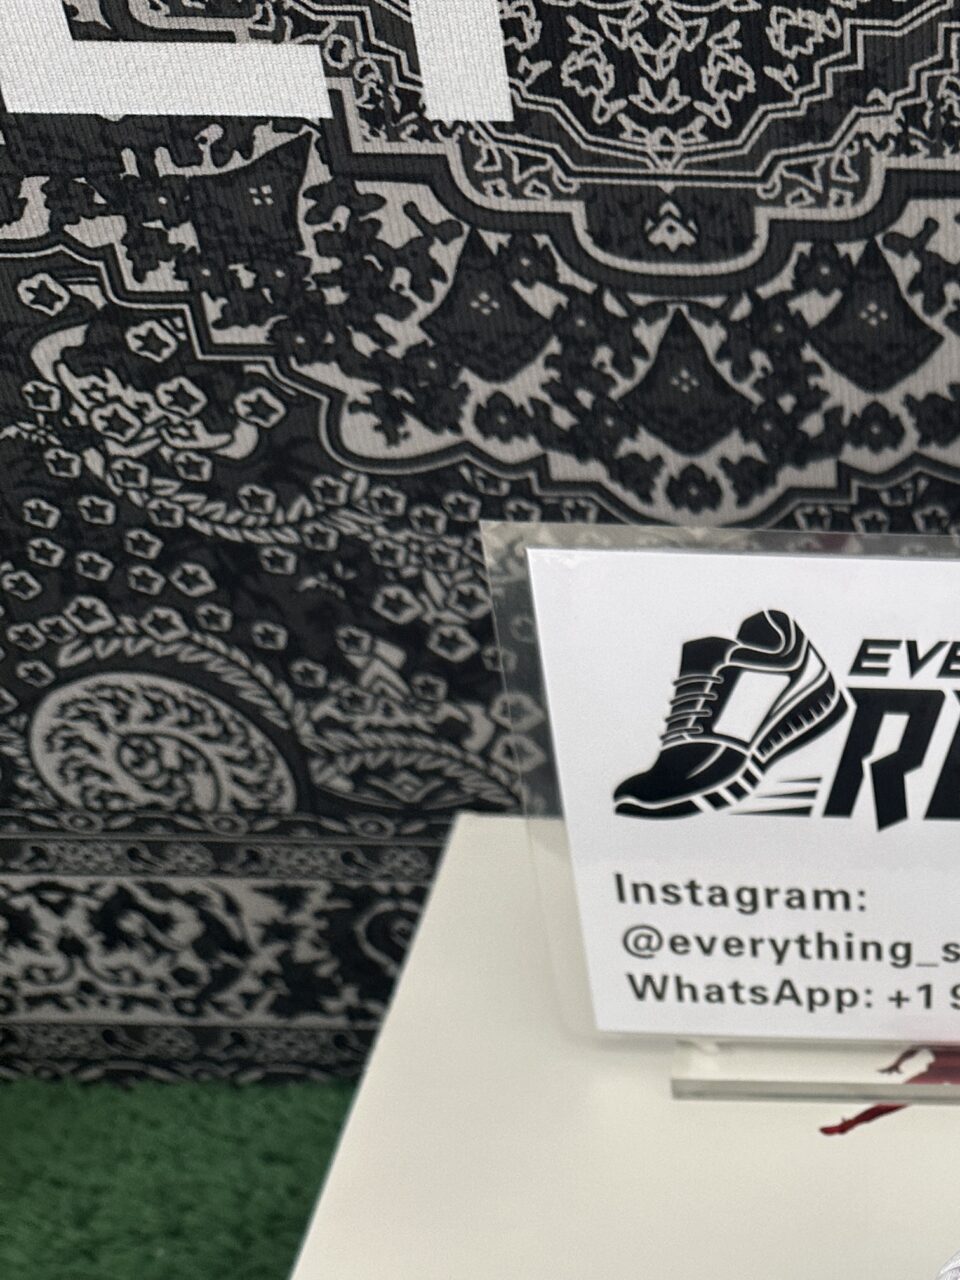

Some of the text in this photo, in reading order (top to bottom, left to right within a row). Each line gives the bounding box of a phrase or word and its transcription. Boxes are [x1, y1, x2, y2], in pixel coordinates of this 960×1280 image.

[614, 873, 867, 914] Instagram:
[626, 973, 874, 1013] WhatsApp:
[888, 984, 933, 1009] +1
